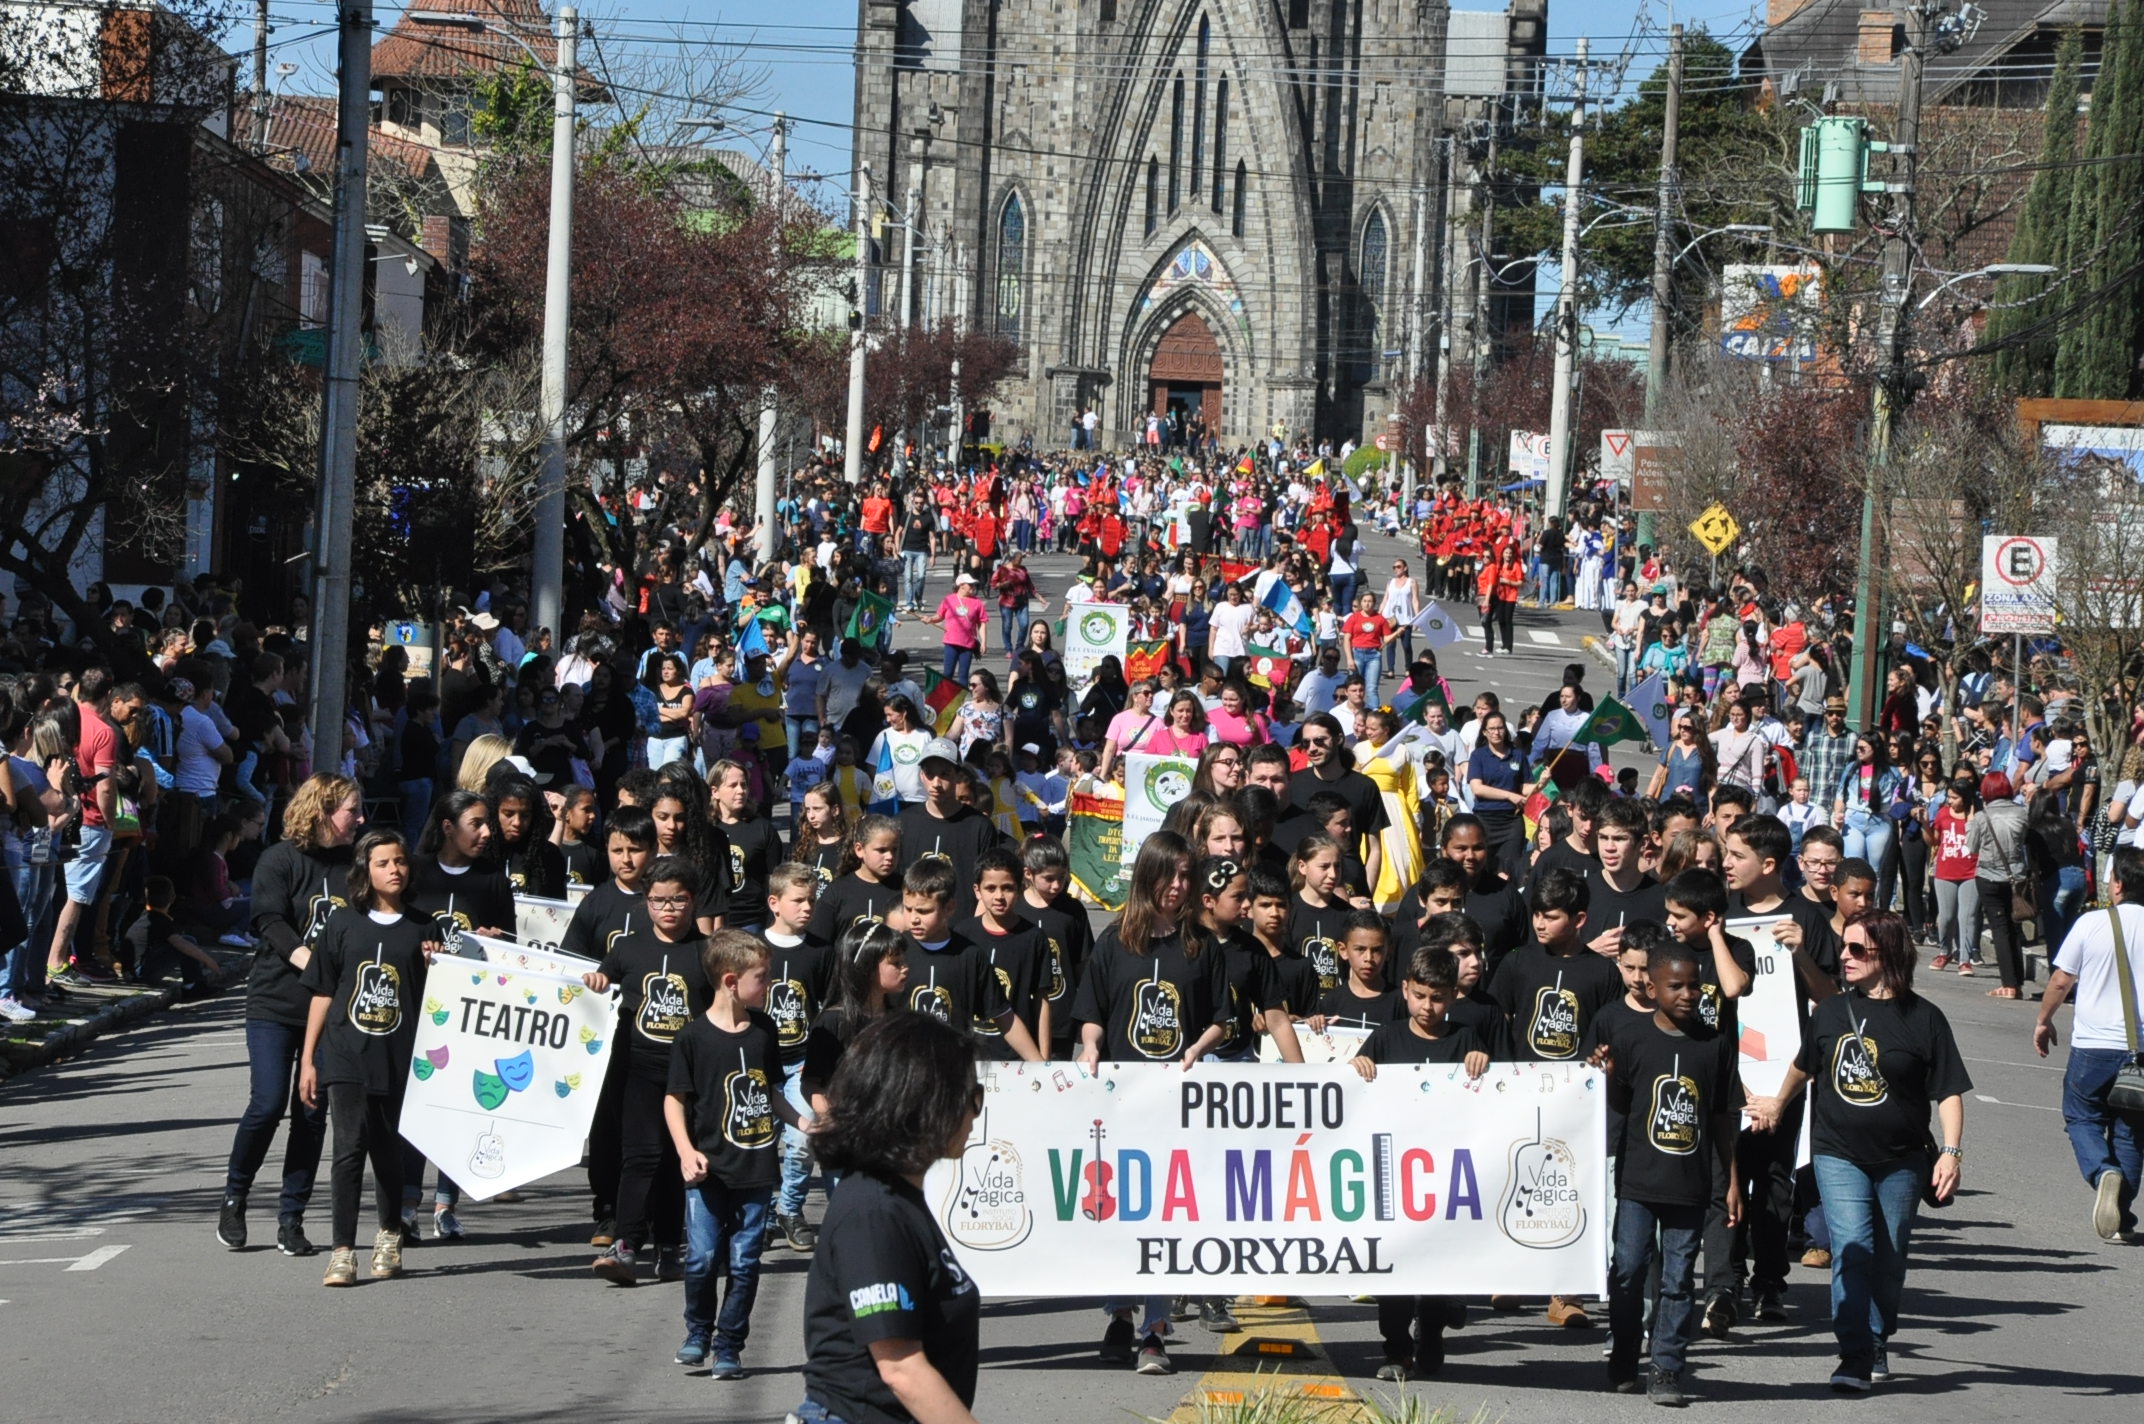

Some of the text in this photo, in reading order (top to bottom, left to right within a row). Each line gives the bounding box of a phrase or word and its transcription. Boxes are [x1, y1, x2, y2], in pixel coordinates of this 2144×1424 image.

[2011, 546, 2032, 576] E
[369, 974, 395, 998] Vida
[656, 984, 683, 1006] Vida
[778, 988, 801, 1010] Vida
[1146, 991, 1173, 1017] Vida
[1547, 998, 1573, 1022] Vida
[461, 997, 570, 1049] TEATRO
[739, 1079, 768, 1106] Vida
[1181, 1080, 1345, 1130] PROJETO
[1666, 1086, 1694, 1113] Vida
[973, 1154, 1014, 1189] Vida
[1048, 1119, 1484, 1223] VIDA MÁGICA
[1528, 1153, 1568, 1187] Vida
[960, 1185, 1024, 1219] Mágica
[1515, 1185, 1579, 1218] Mágica
[959, 1221, 1017, 1231] FLORYBAL
[1515, 1220, 1572, 1230] FLORYBAL
[1136, 1236, 1394, 1276] FLORYBAL
[849, 1282, 899, 1312] CANELA
